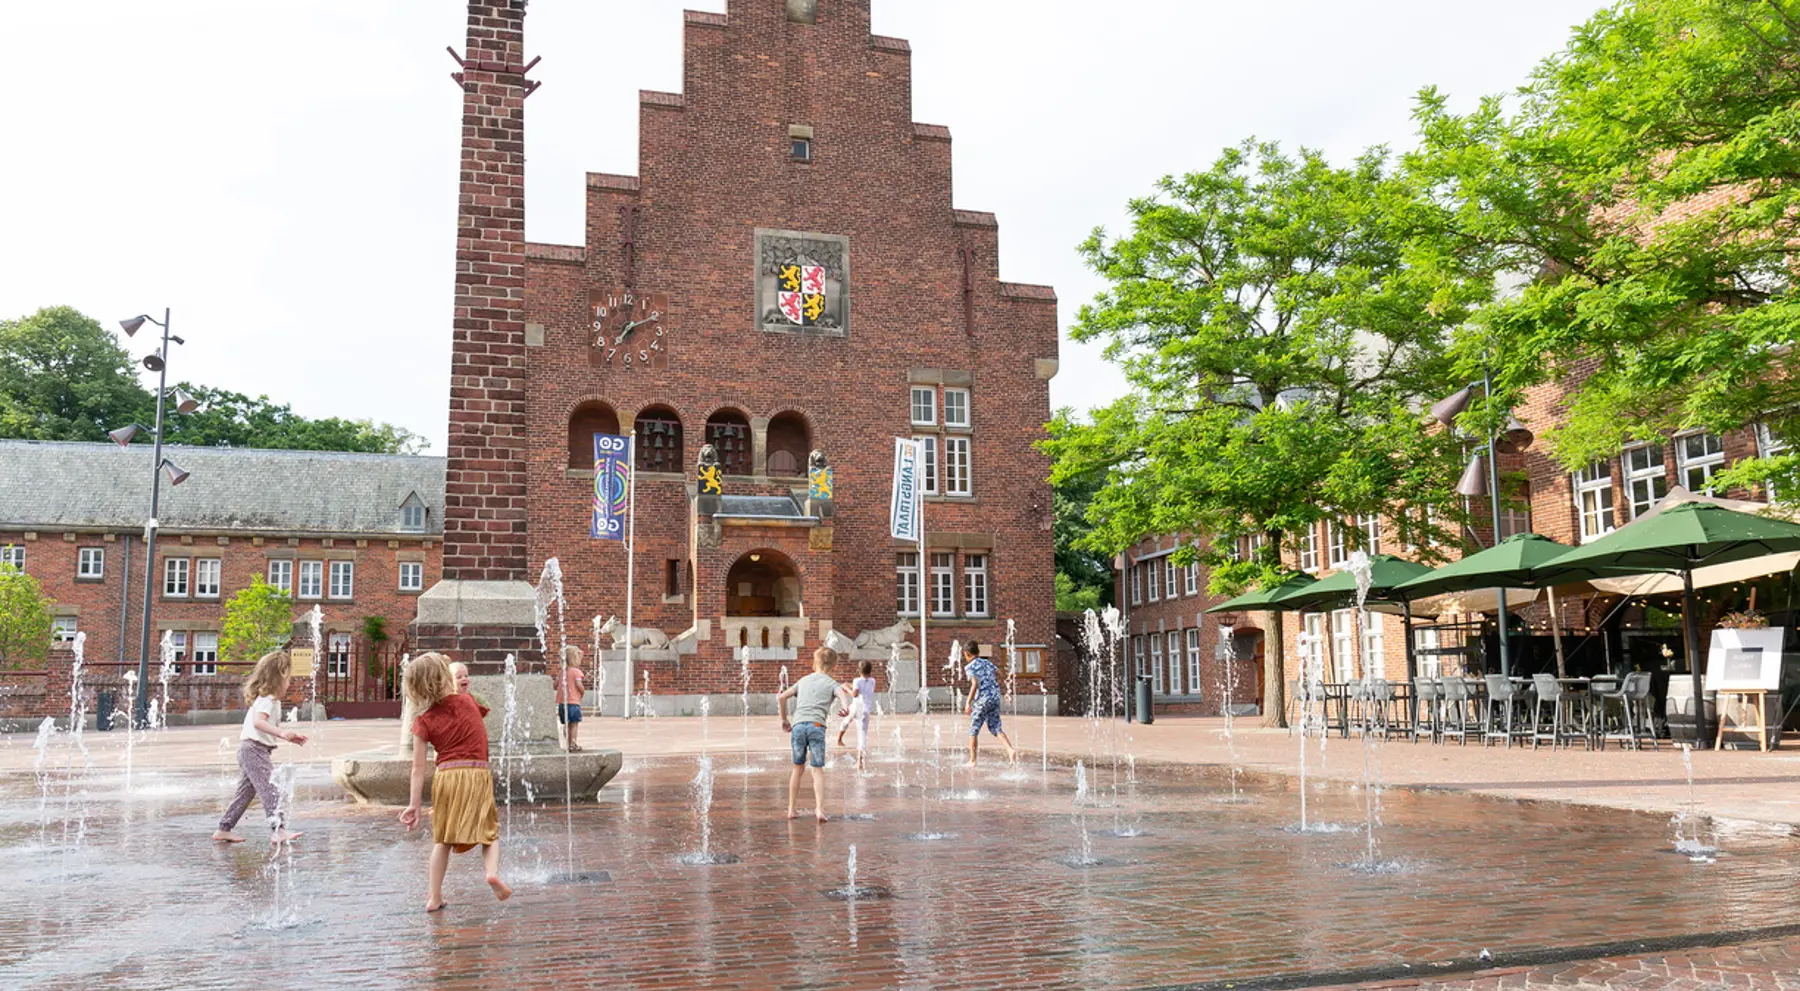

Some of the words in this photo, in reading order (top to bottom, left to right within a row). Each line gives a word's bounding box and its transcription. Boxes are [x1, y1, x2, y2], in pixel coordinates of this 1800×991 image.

[608, 297, 617, 308] 11
[624, 294, 633, 306] 12
[642, 300, 646, 310] 1
[596, 306, 607, 317] 10
[593, 321, 601, 332] 9
[655, 326, 663, 337] 3
[596, 336, 605, 347] 8
[650, 340, 659, 351] 4
[608, 348, 616, 359] 7
[623, 353, 632, 363] 6
[640, 350, 648, 361] 5
